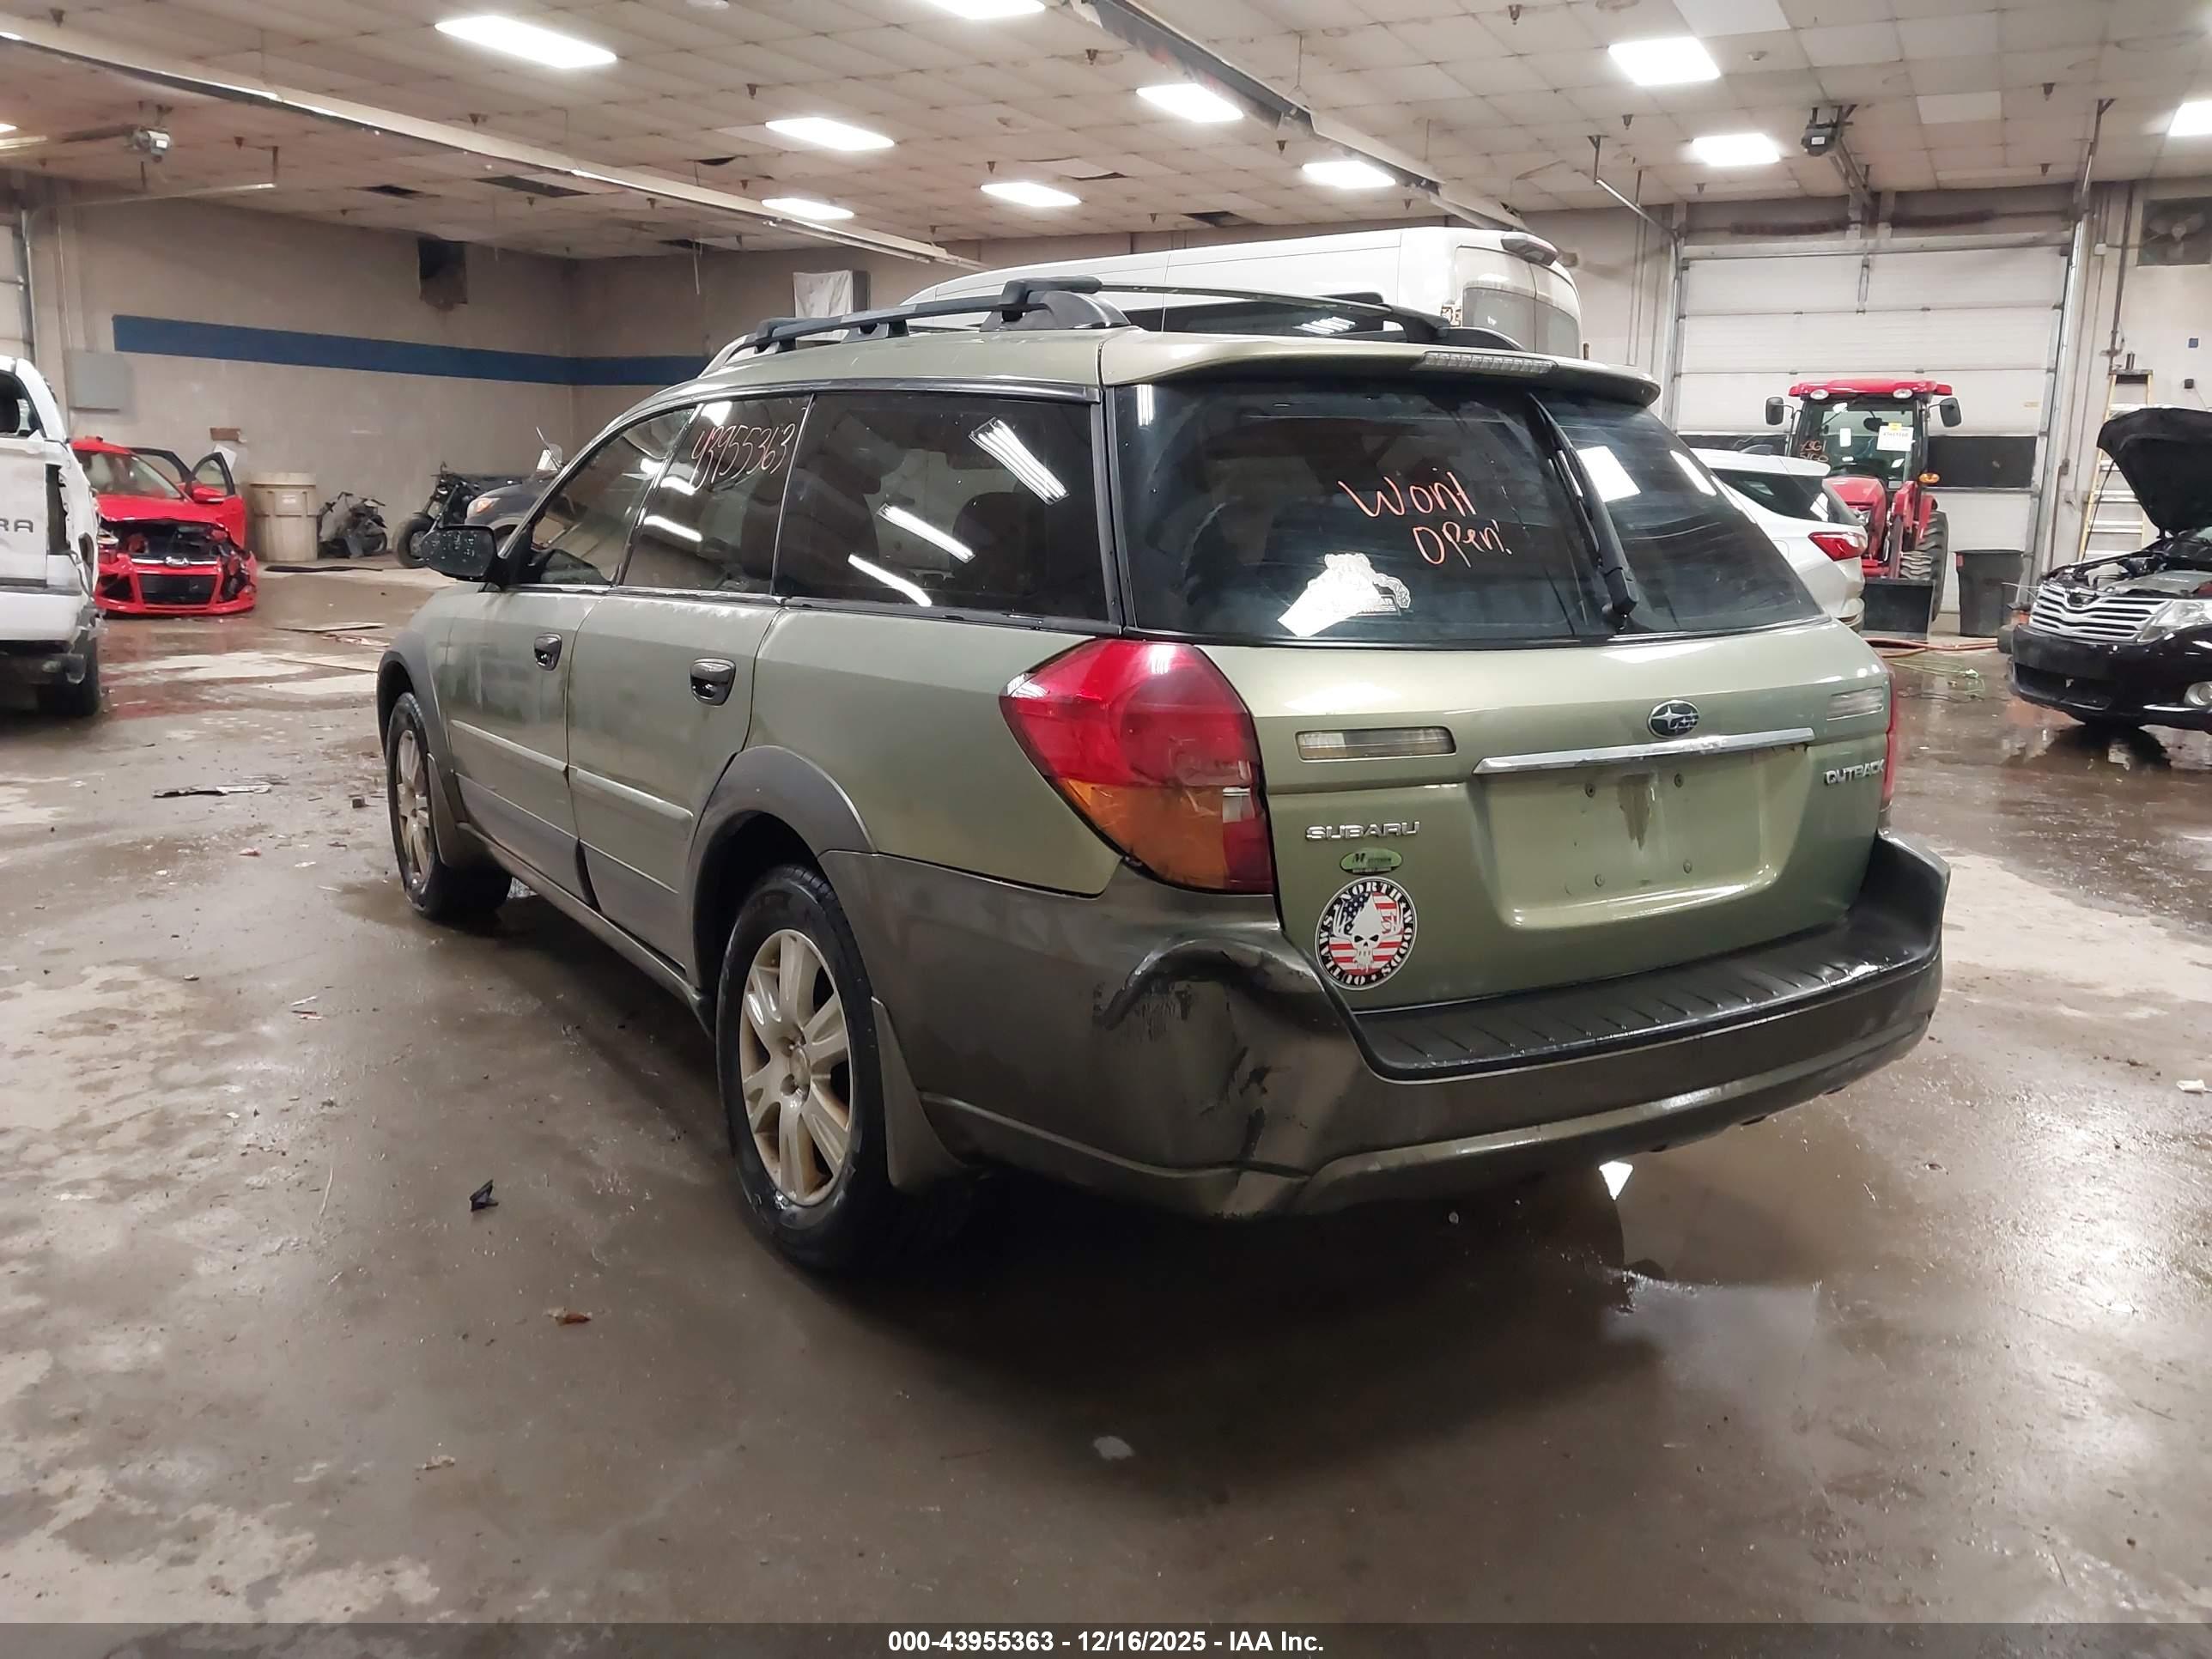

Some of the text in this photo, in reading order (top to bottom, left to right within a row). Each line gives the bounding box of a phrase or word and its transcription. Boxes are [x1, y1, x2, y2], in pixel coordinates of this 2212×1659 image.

[1824, 758, 1885, 785] OUTBACK
[1305, 821, 1420, 841] SUBARU
[1340, 881, 1402, 902] NORTH
[1318, 915, 1366, 986] OUTLAWS
[1381, 908, 1414, 977] WOODS
